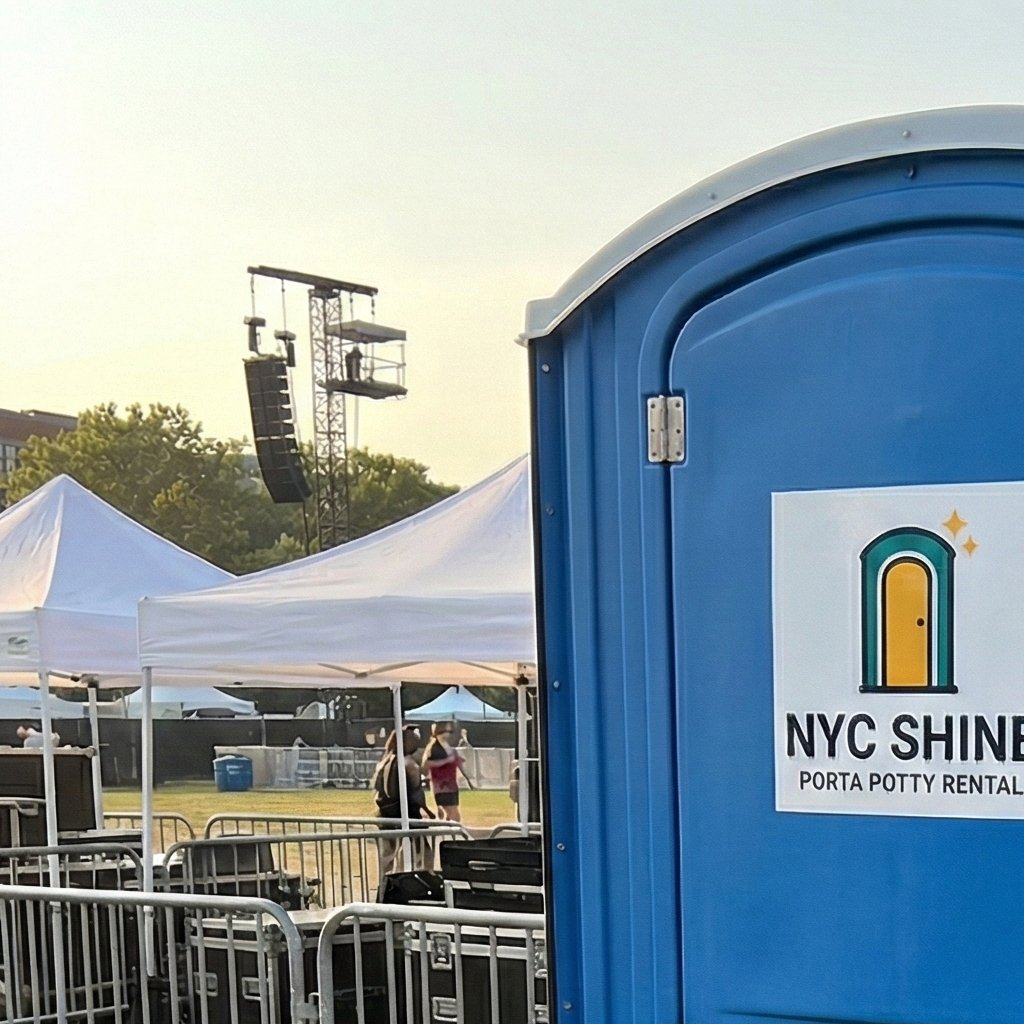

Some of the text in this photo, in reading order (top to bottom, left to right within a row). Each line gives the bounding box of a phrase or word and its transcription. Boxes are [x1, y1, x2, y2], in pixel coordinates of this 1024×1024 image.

[786, 713, 877, 760] NYC
[799, 770, 1024, 796] PORTA POTTY RENTAL
